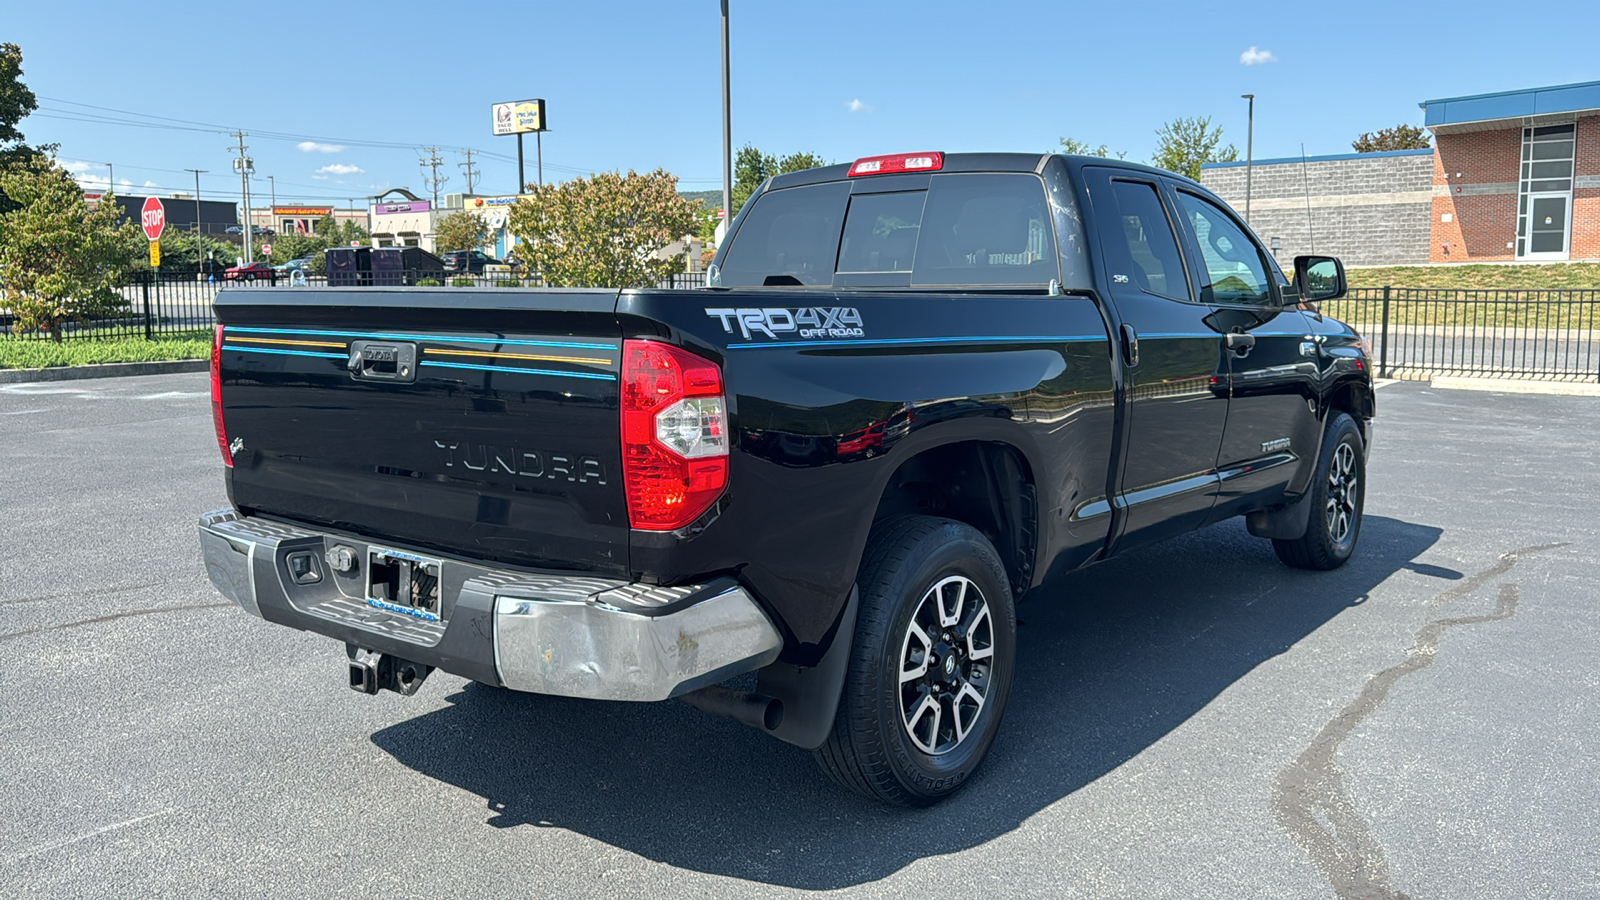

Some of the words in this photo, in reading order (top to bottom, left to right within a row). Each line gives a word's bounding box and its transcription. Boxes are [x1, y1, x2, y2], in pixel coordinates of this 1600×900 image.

[143, 209, 163, 227] STOP
[704, 308, 798, 340] TRD
[800, 328, 828, 338] OFF
[829, 328, 865, 338] ROAD
[364, 350, 393, 360] TOYOTA
[434, 440, 607, 485] TUNDRA
